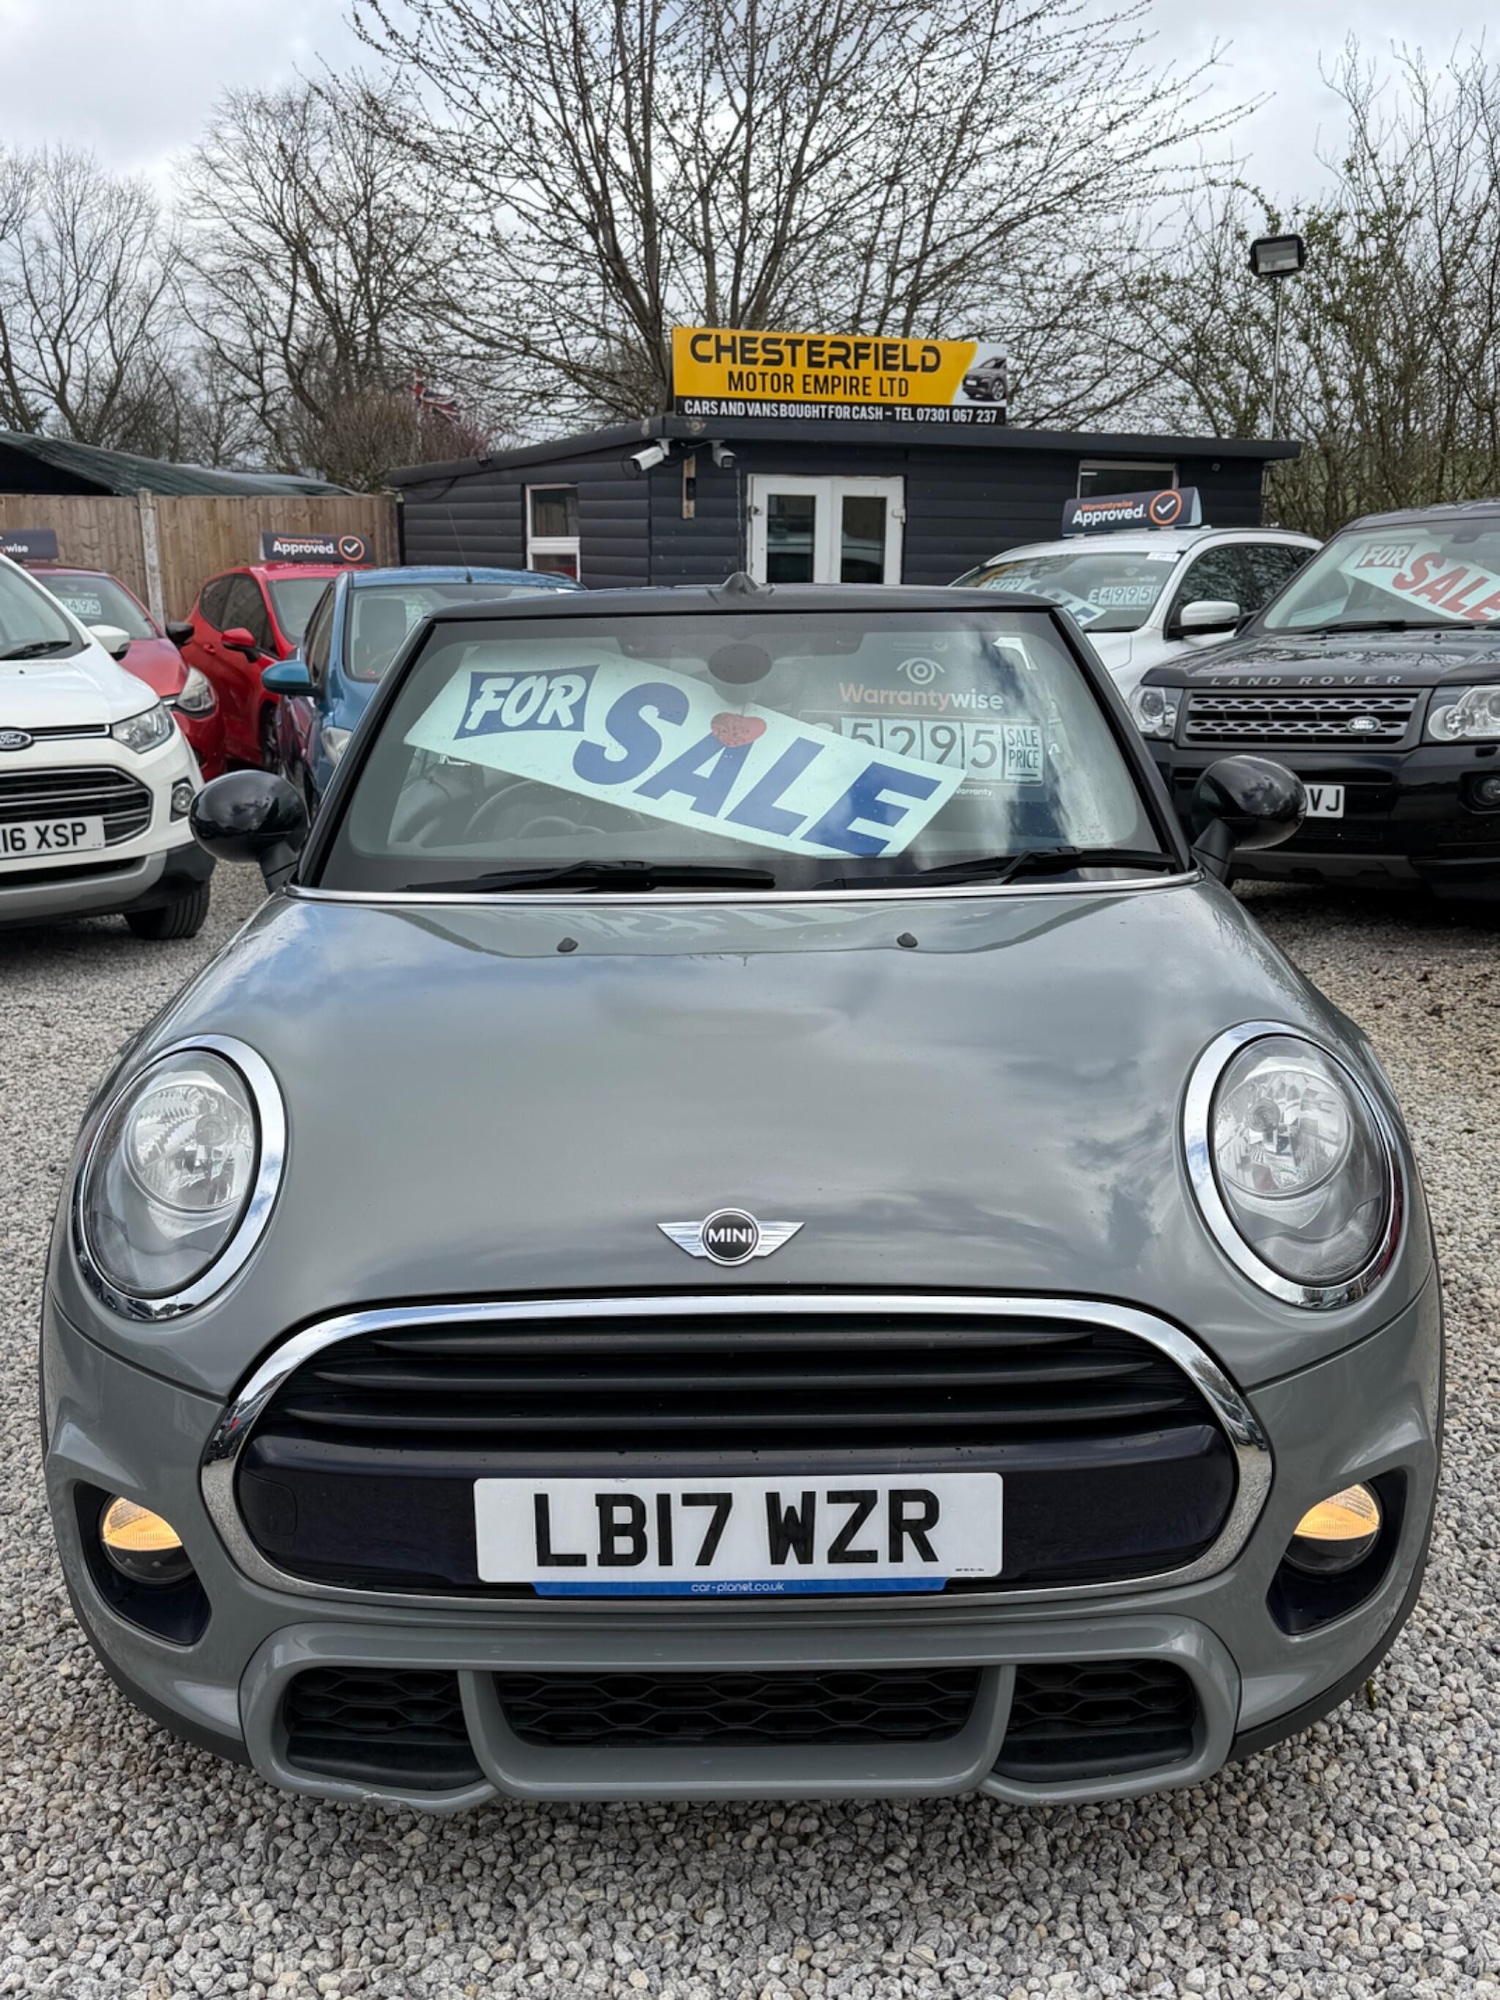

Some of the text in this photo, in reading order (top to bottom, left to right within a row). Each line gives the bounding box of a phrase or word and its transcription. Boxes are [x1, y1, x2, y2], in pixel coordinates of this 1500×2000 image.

[690, 333, 941, 373] CHESTERFIELD
[728, 371, 909, 398] MOTOR EMPIRE LTD
[684, 400, 718, 415] CARS
[720, 401, 745, 416] AND
[746, 402, 779, 417] VANS
[780, 404, 829, 419] BOUGHT
[829, 405, 850, 420] FOR
[852, 406, 883, 421] CASH
[894, 407, 914, 421] TEL
[917, 408, 949, 422] 07301
[952, 409, 972, 423] 067
[976, 410, 996, 423] 237
[1072, 504, 1147, 527] Approved.
[1359, 544, 1410, 567] FOR
[1210, 675, 1402, 686] LAND ROVER
[839, 682, 1005, 711] Warrantywise
[850, 722, 998, 769] 5295
[1008, 729, 1039, 748] SALE
[464, 674, 943, 857] FOR SALE
[1008, 750, 1039, 769] PRICE
[1309, 788, 1341, 812] VJ
[0, 822, 87, 853] 16 XSP
[708, 1227, 753, 1244] MINI
[533, 1489, 941, 1567] LB17 WZR
[691, 1582, 785, 1593] car-planet.co.uk
